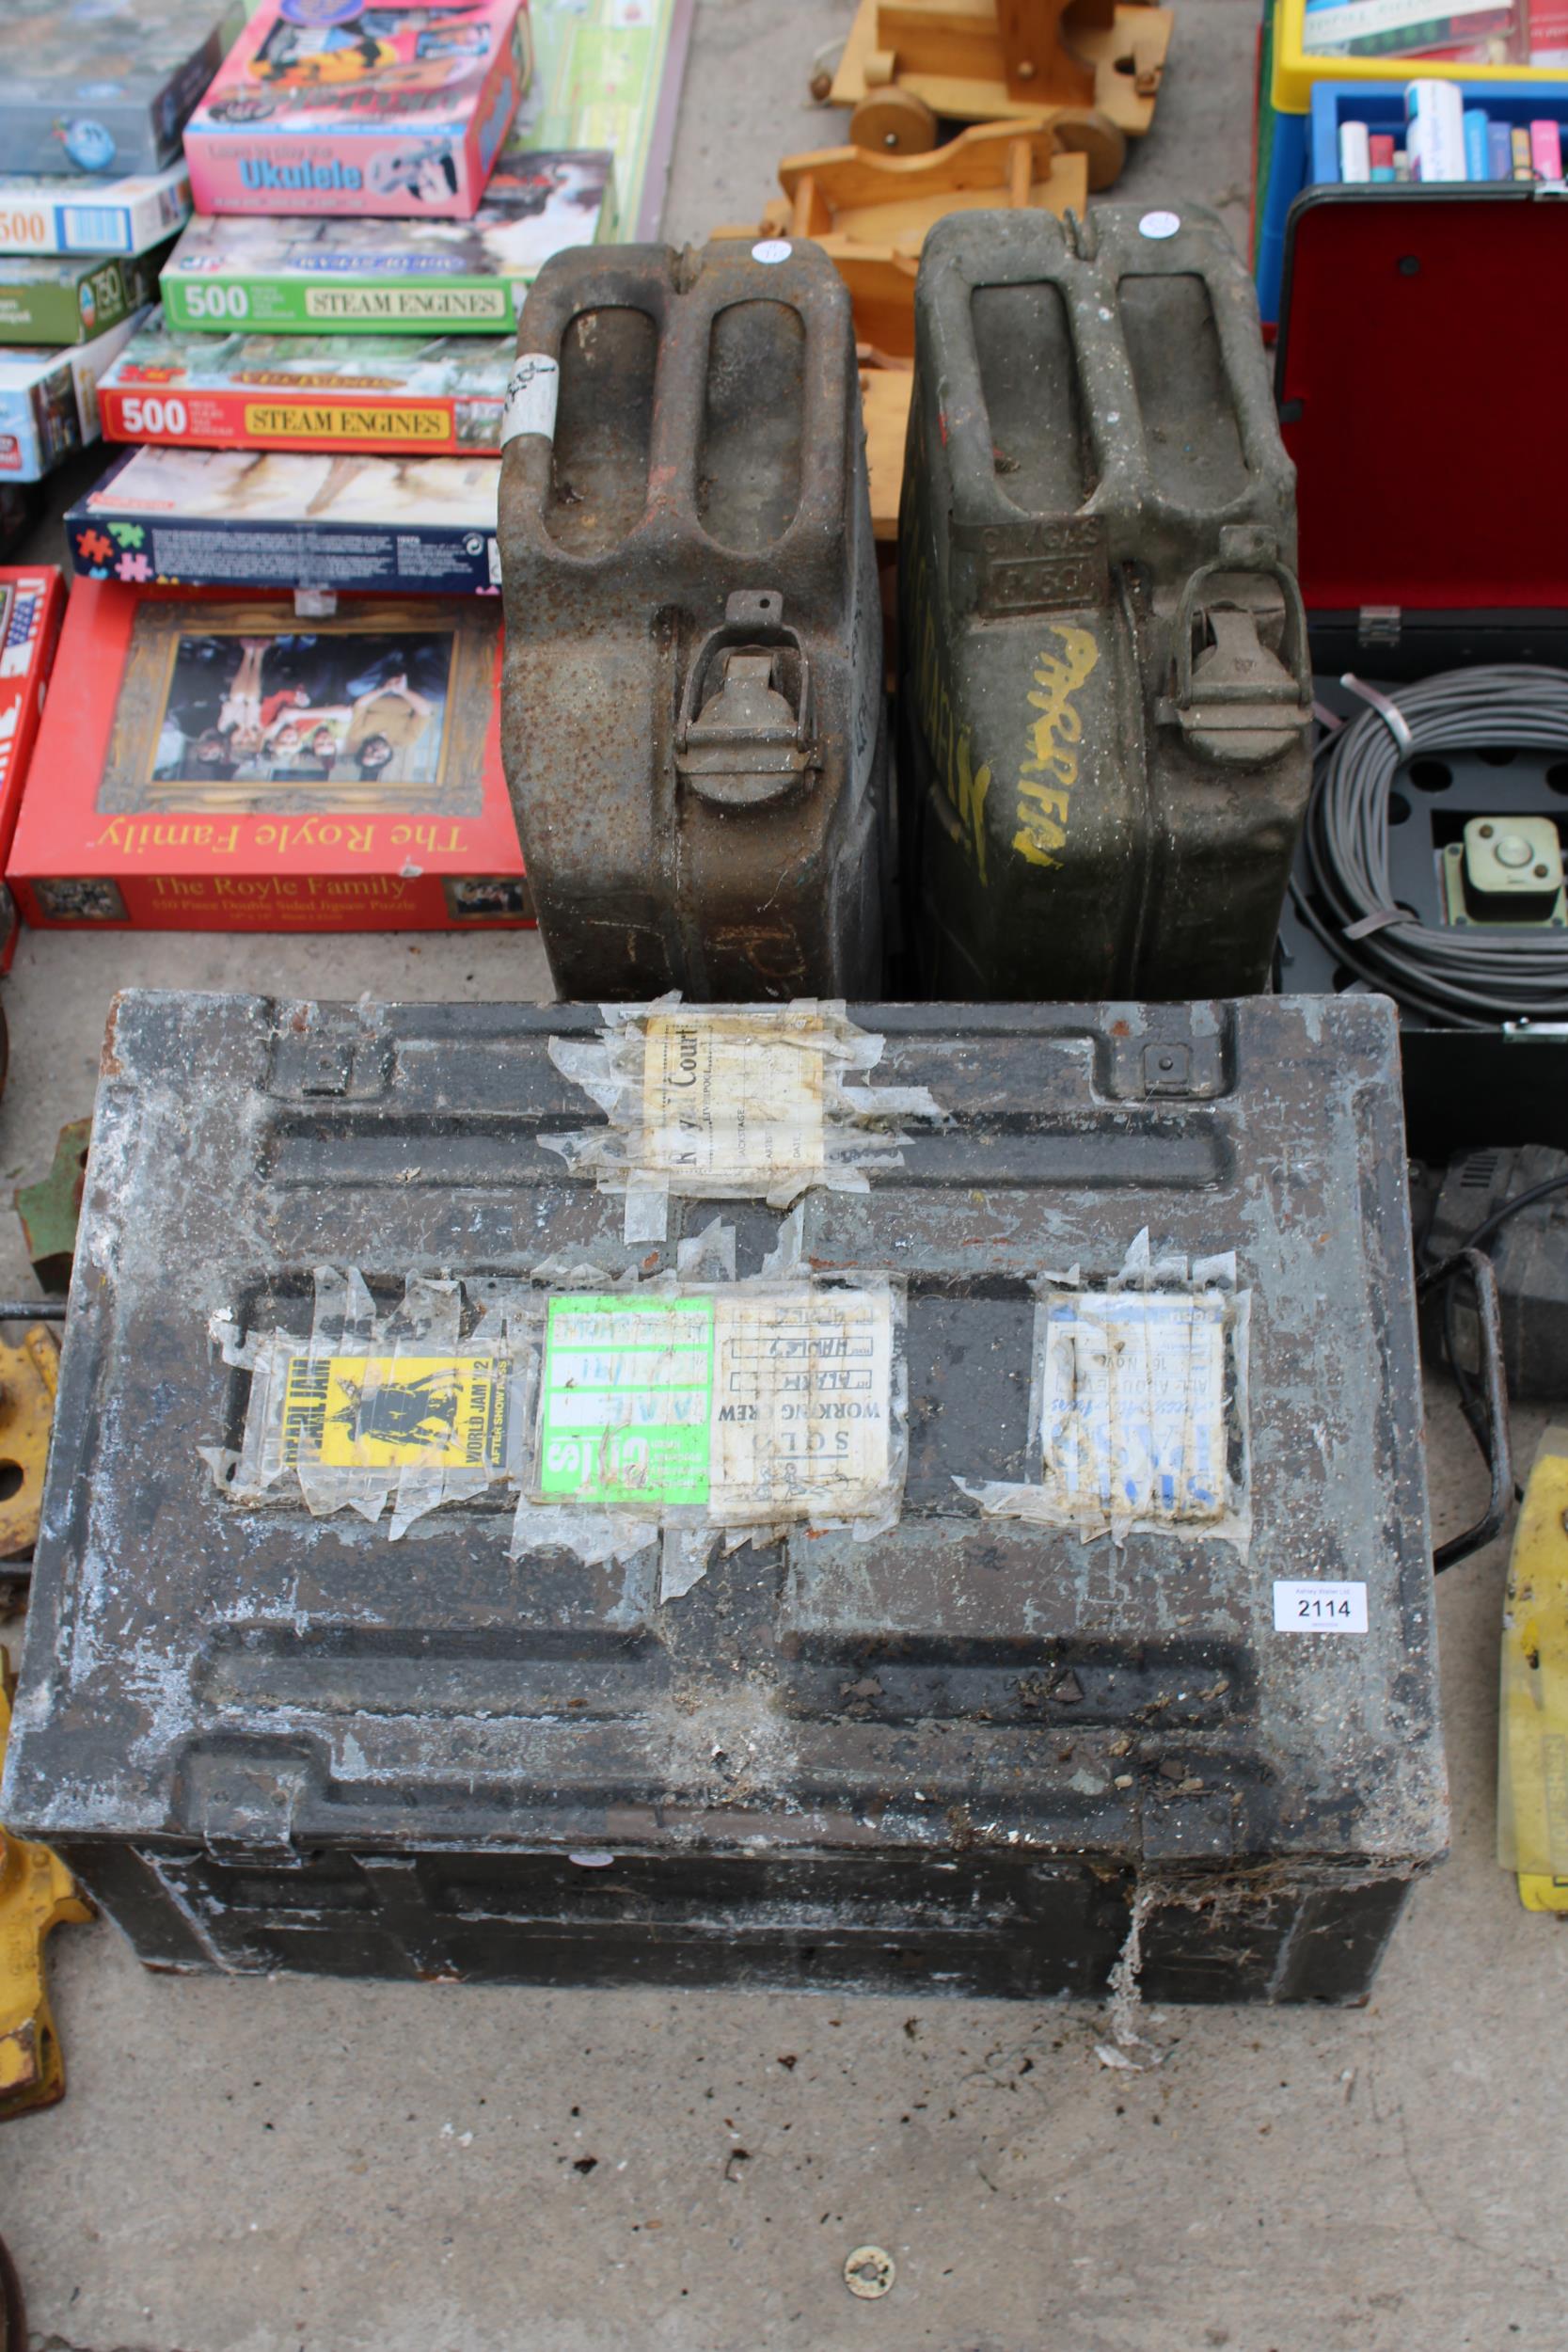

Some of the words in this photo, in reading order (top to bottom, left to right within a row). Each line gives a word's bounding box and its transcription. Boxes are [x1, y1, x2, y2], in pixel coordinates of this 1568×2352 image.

[238, 157, 363, 191] Ukulele
[184, 285, 247, 318] 500
[313, 293, 390, 313] STEAM
[398, 293, 496, 314] ENGINES
[121, 397, 186, 434] 500
[252, 410, 333, 431] STEAM
[340, 412, 441, 434] ENGINES
[97, 817, 241, 855] Family
[254, 817, 375, 853] Royle
[390, 823, 468, 853] The
[149, 876, 204, 895] The
[214, 876, 298, 900] Royle
[309, 876, 406, 899] Family
[667, 1029, 697, 1088] Court
[289, 1359, 331, 1400] JAM
[472, 1360, 490, 1382] '2
[470, 1384, 487, 1413] JAM
[492, 1391, 506, 1425] SHOW
[781, 1402, 881, 1421] WORKNG
[284, 1403, 327, 1464] PEARL
[466, 1415, 485, 1464] WORLD
[491, 1426, 504, 1465] AFTER
[1298, 1599, 1351, 1618] 2114
